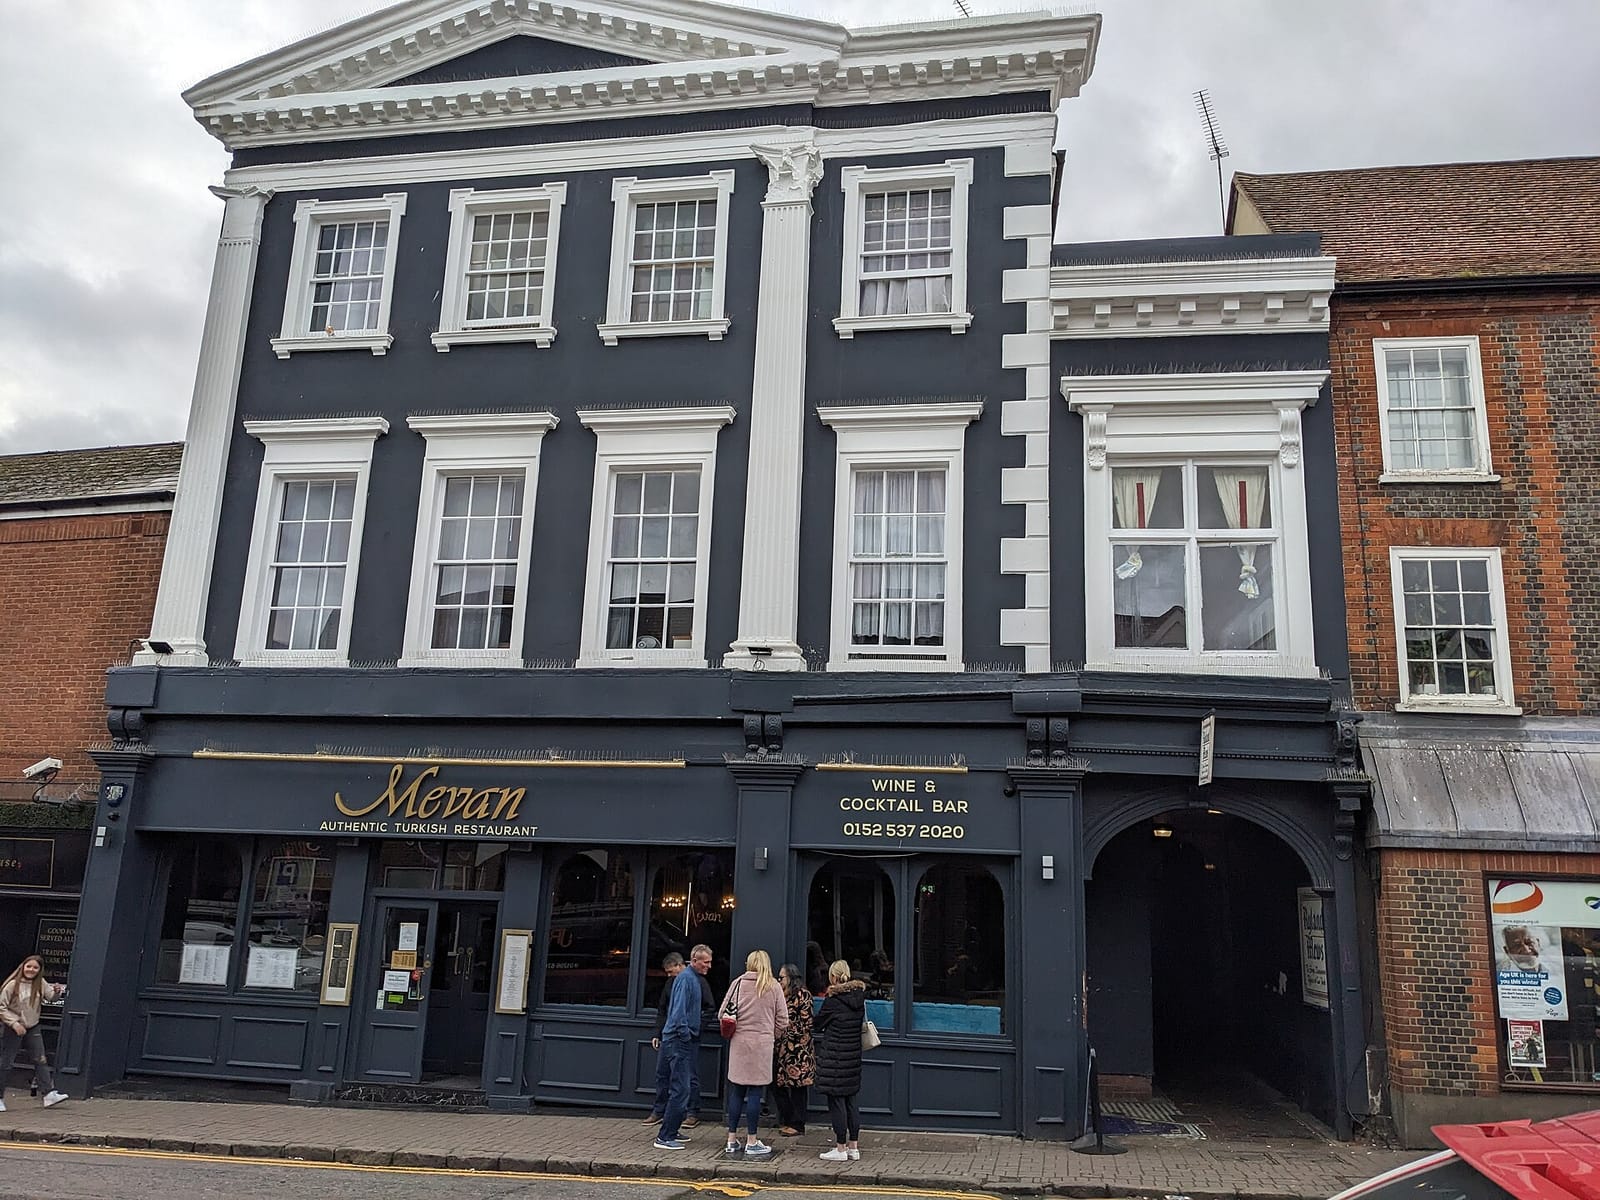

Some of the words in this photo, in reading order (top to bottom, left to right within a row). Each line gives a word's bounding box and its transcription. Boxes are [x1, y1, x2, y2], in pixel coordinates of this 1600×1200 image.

[334, 763, 528, 821] Mevan
[871, 779, 916, 793] WINE
[924, 780, 936, 793] &
[840, 798, 924, 812] COCKTAIL
[932, 799, 969, 814] BAR
[319, 821, 388, 832] AUTHENTIC
[394, 823, 447, 834] TURKISH
[454, 824, 539, 837] RESTAURANT
[843, 822, 882, 836] 0152
[886, 824, 916, 837] 537
[919, 825, 964, 839] 2020
[1499, 971, 1510, 979] Age
